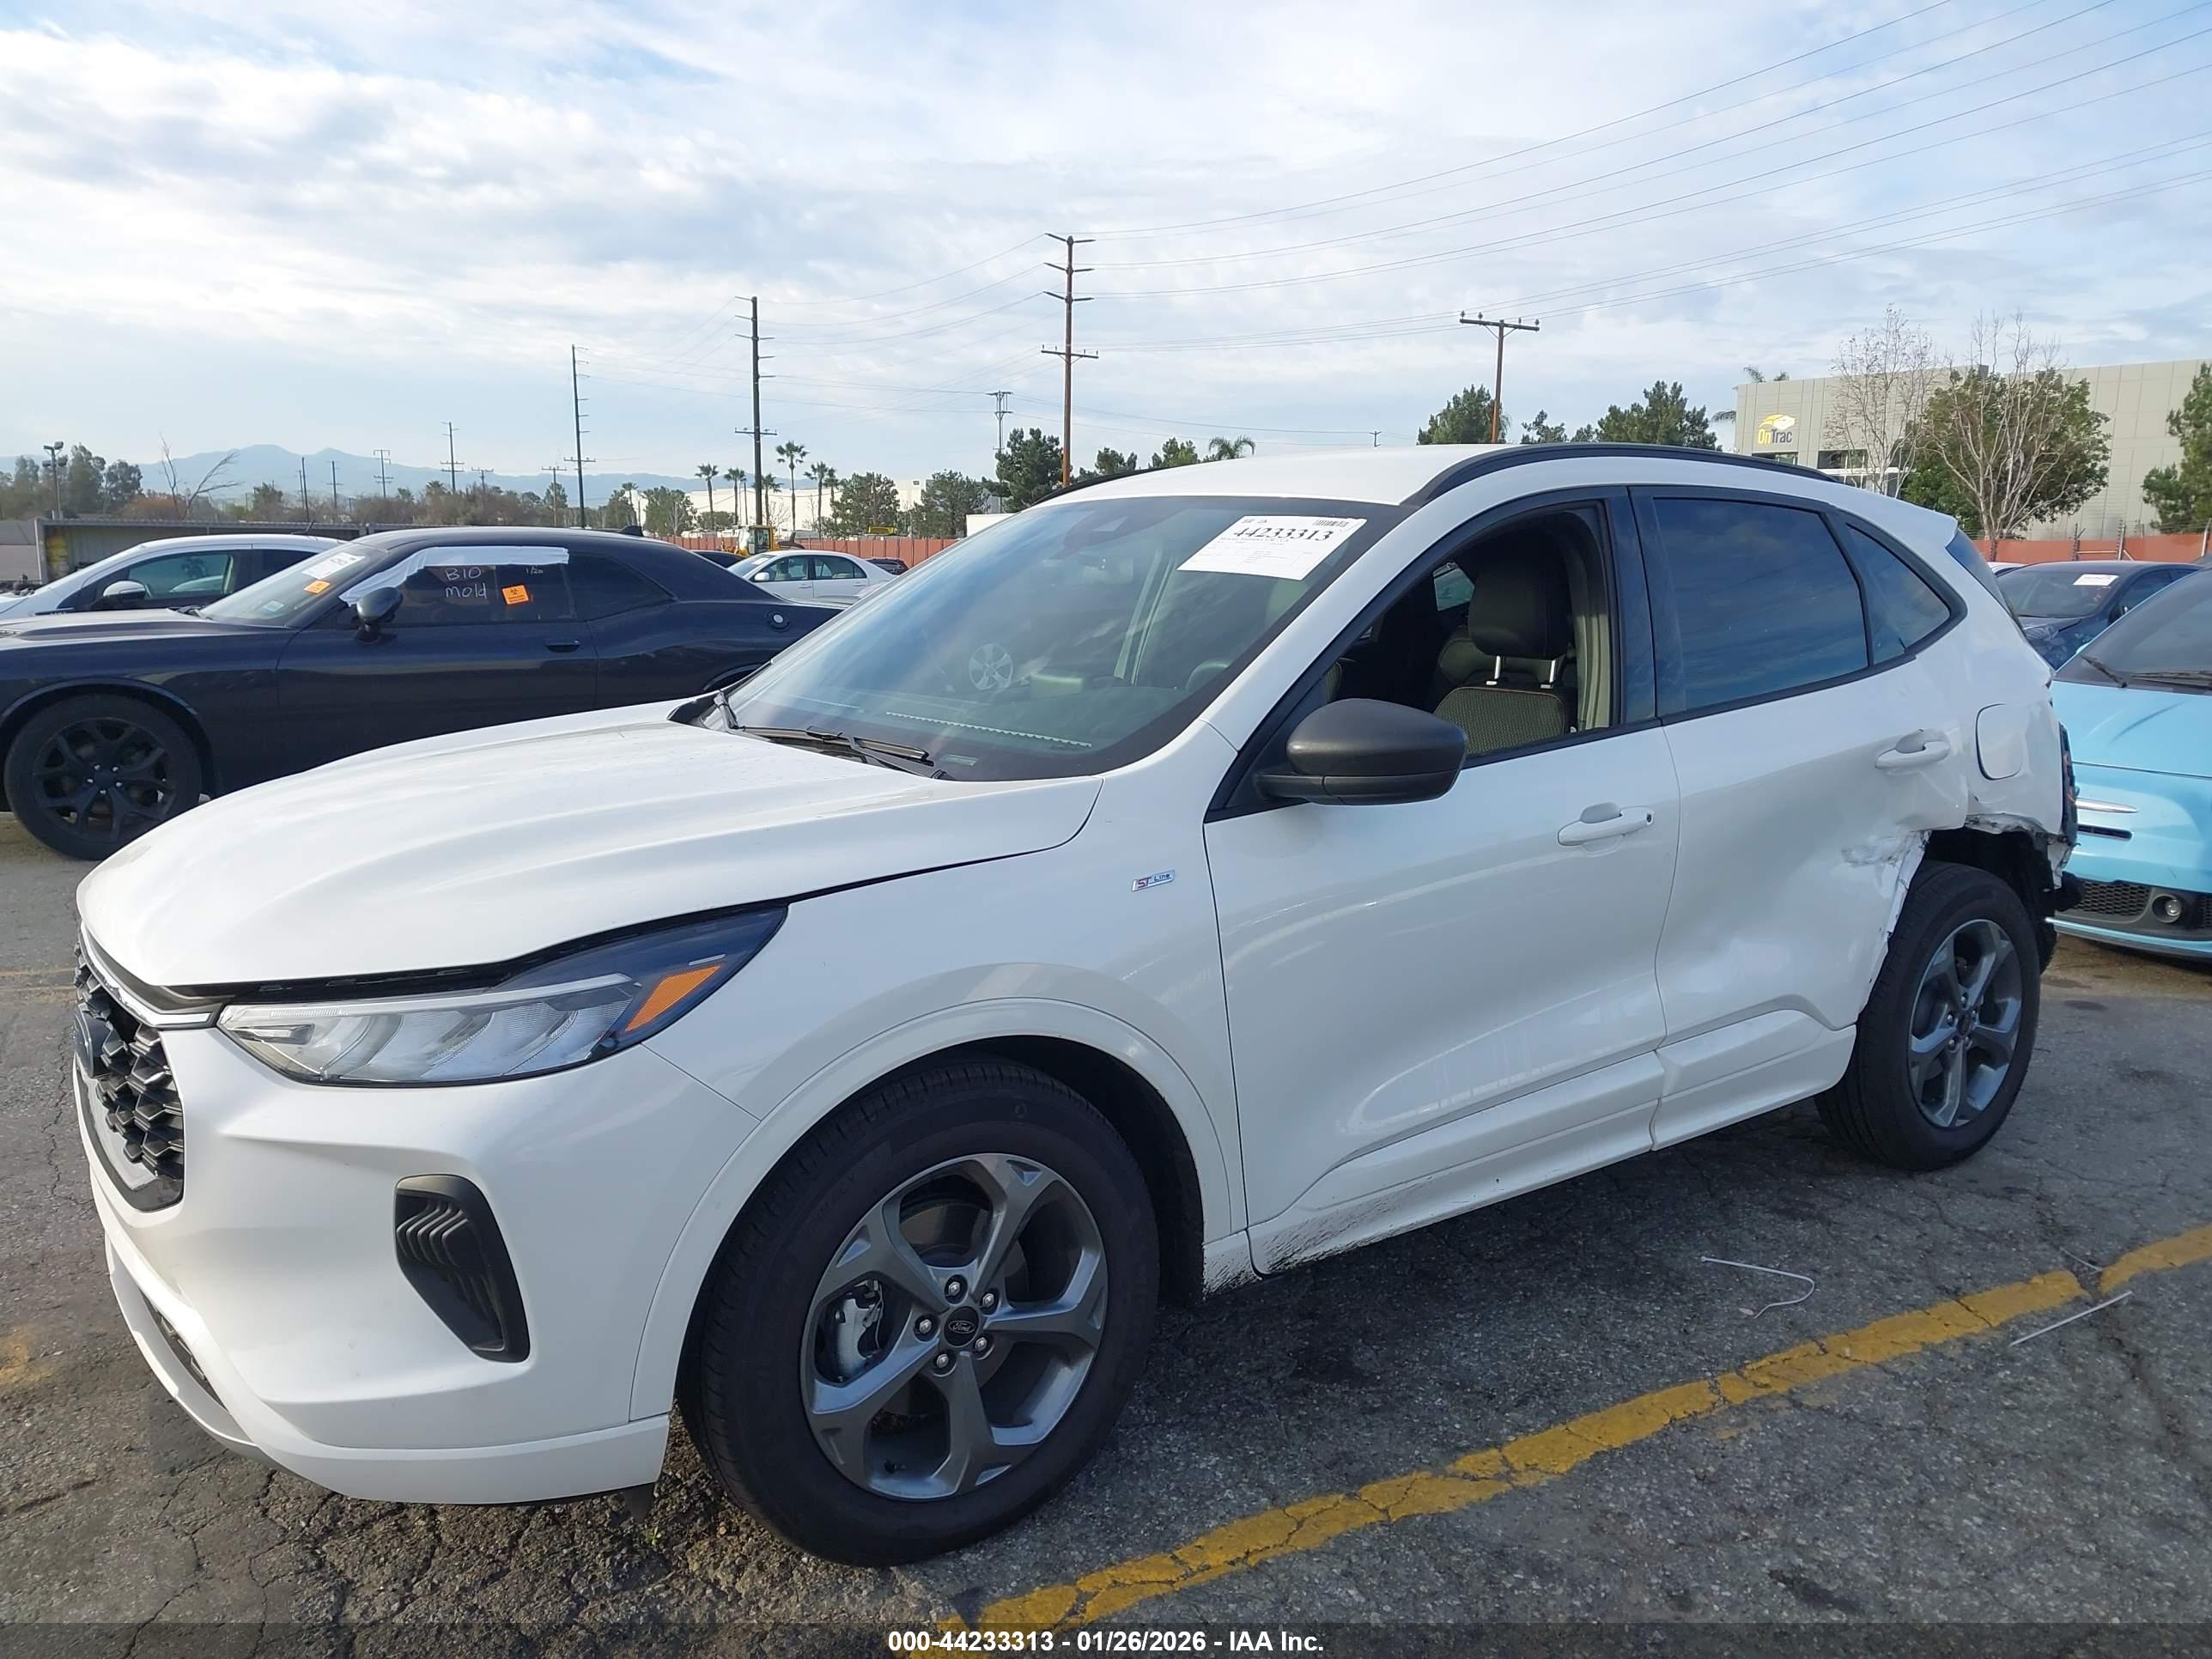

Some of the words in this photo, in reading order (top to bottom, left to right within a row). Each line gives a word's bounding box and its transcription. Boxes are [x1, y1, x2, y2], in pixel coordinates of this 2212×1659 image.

[1758, 428, 1793, 445] OnTrac
[1233, 527, 1334, 541] 44233313
[951, 1322, 971, 1333] Ford
